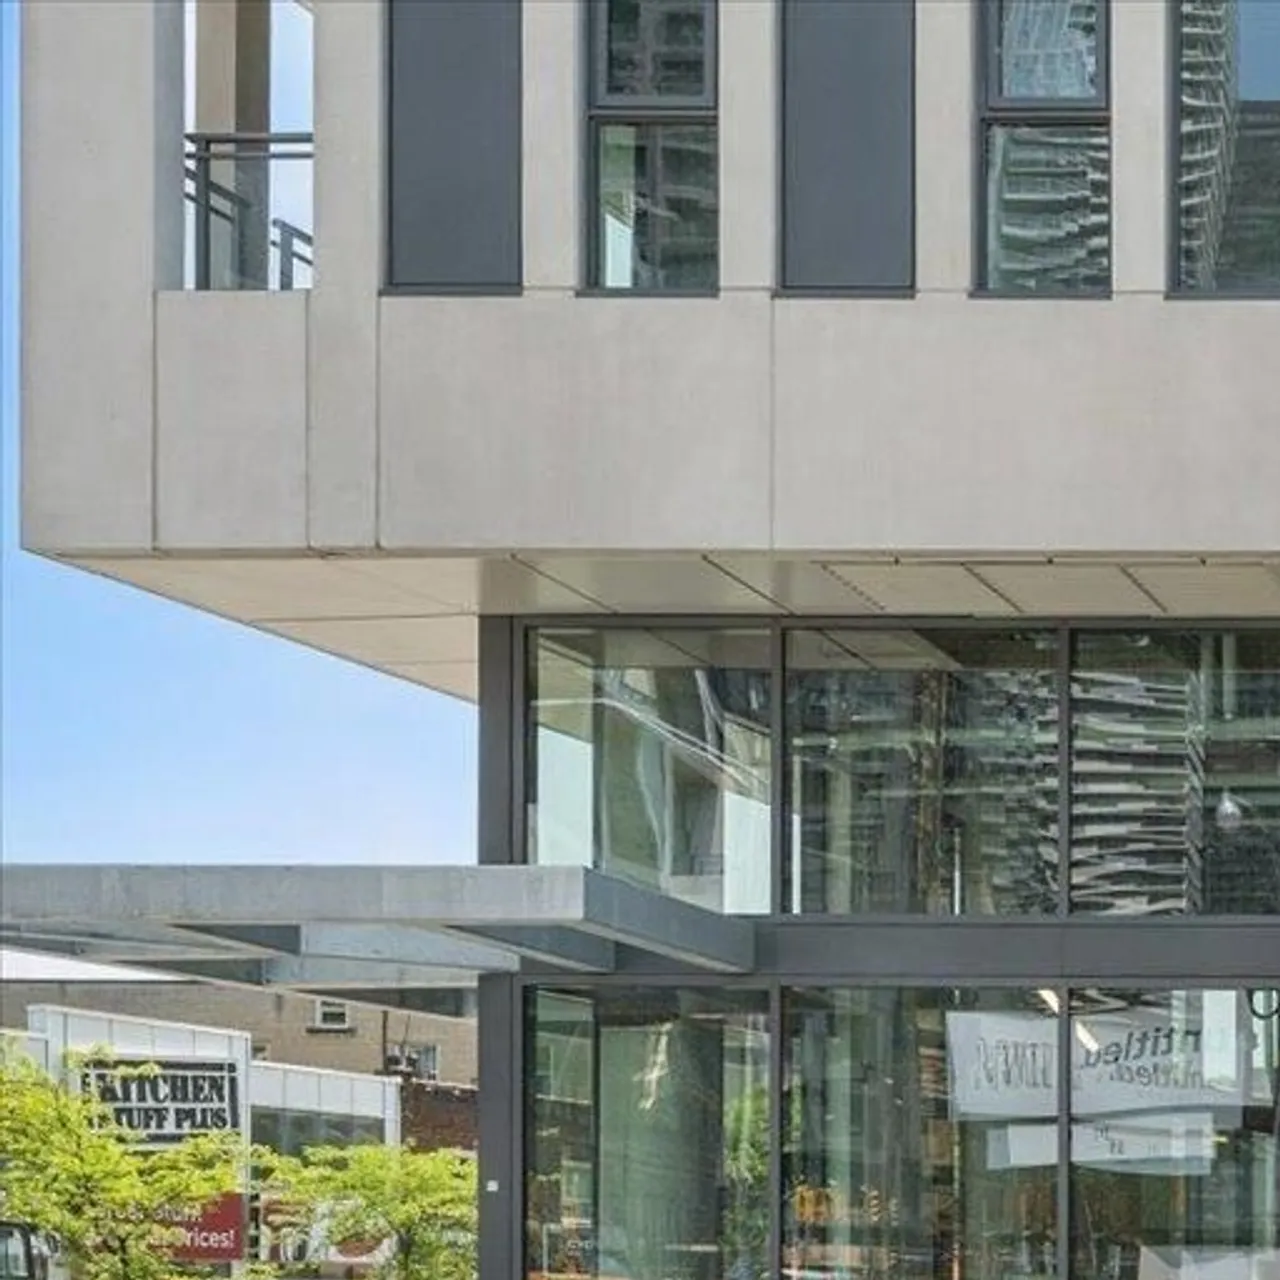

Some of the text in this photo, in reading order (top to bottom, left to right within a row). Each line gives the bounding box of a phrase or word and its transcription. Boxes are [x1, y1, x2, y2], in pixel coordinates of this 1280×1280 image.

[97, 1106, 229, 1130] TUFF PLUS
[177, 1228, 236, 1249] rices!
